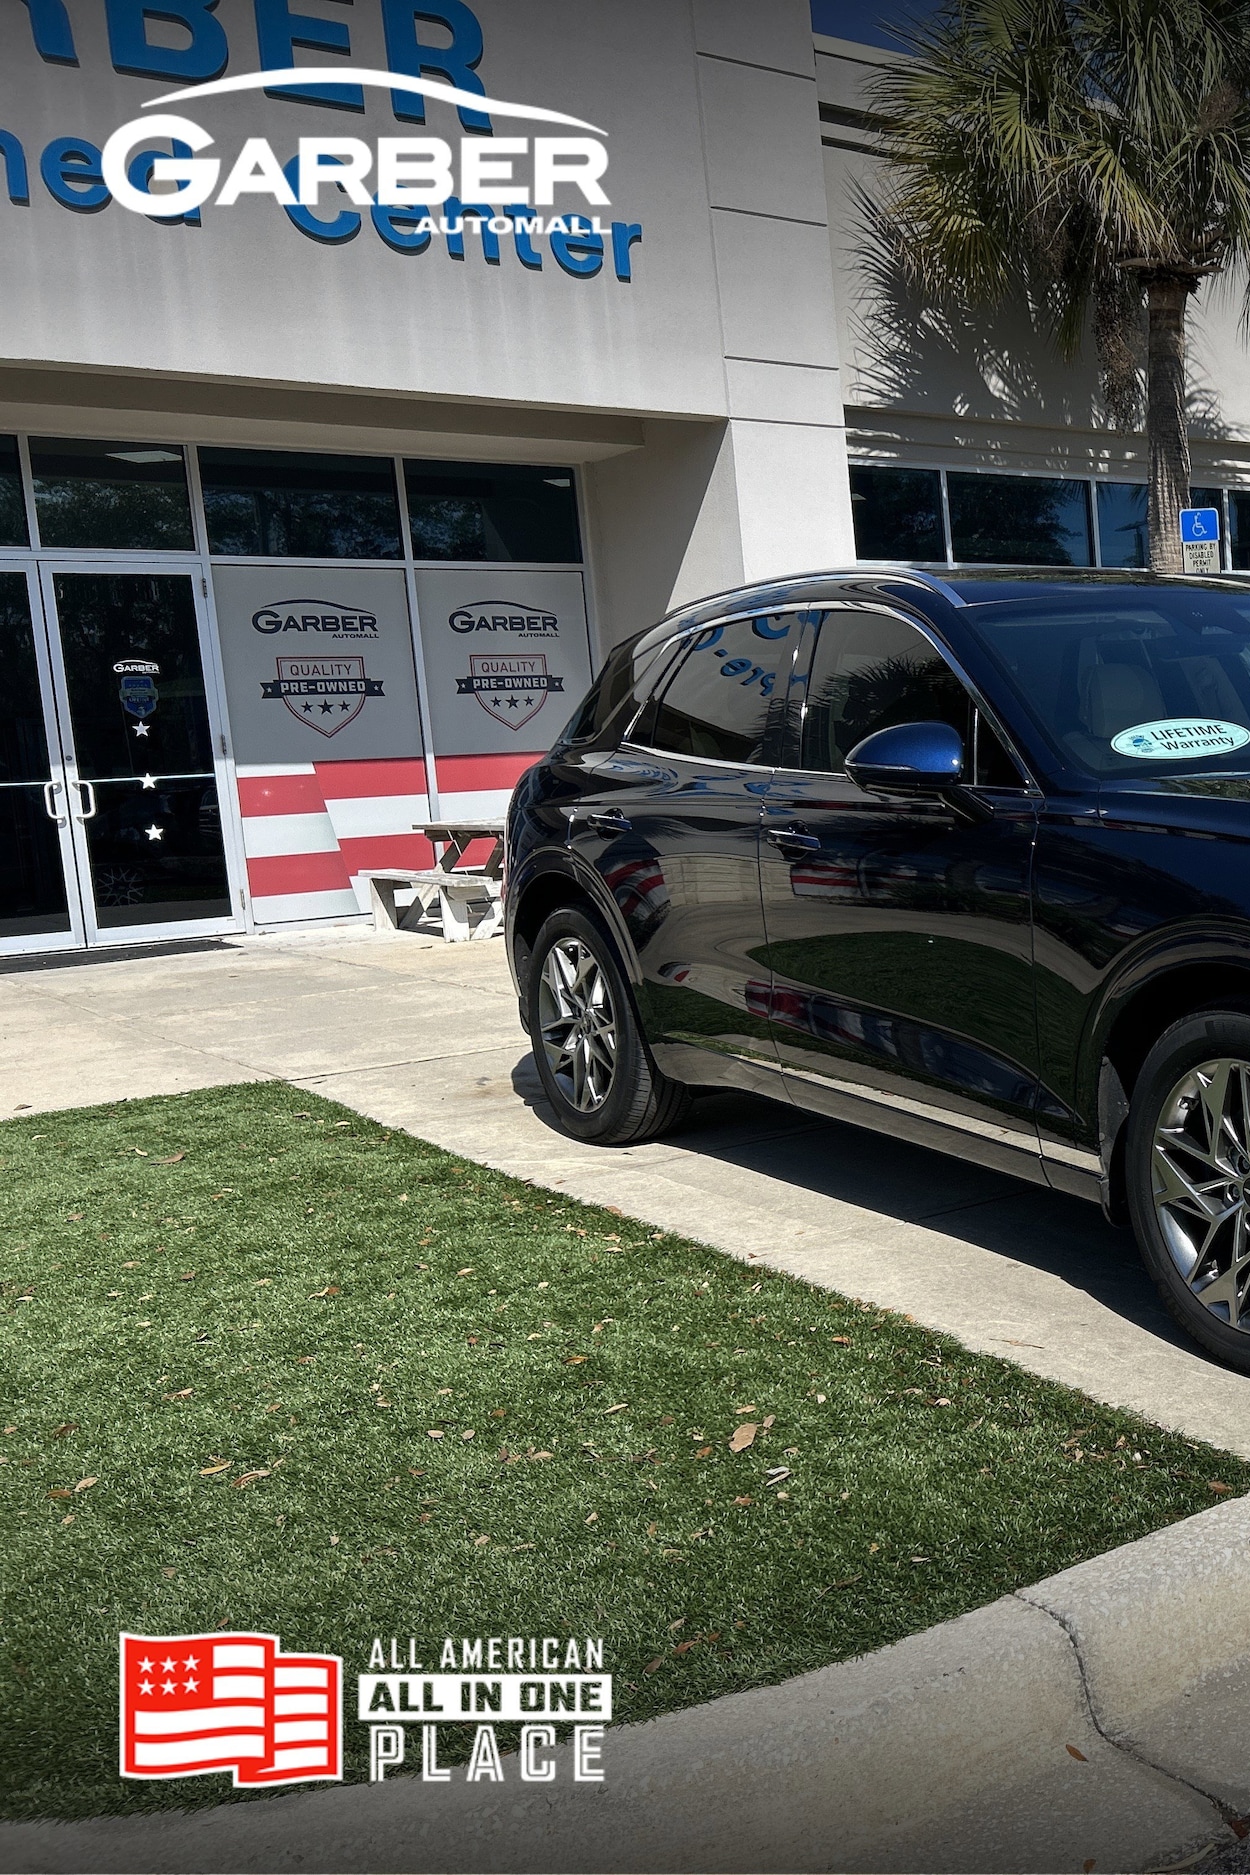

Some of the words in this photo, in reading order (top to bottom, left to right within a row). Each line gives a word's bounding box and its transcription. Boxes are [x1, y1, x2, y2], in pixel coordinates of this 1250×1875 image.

[251, 610, 378, 635] GARBER
[448, 610, 559, 634] GARBER
[113, 663, 160, 673] GARBER
[289, 663, 352, 677] QUALITY
[481, 661, 536, 674] QUALITY
[279, 680, 367, 694] PRE-OWNED
[472, 676, 548, 690] PRE-OWNED
[1151, 724, 1228, 741] LIFETIME
[1160, 737, 1235, 751] Warranty
